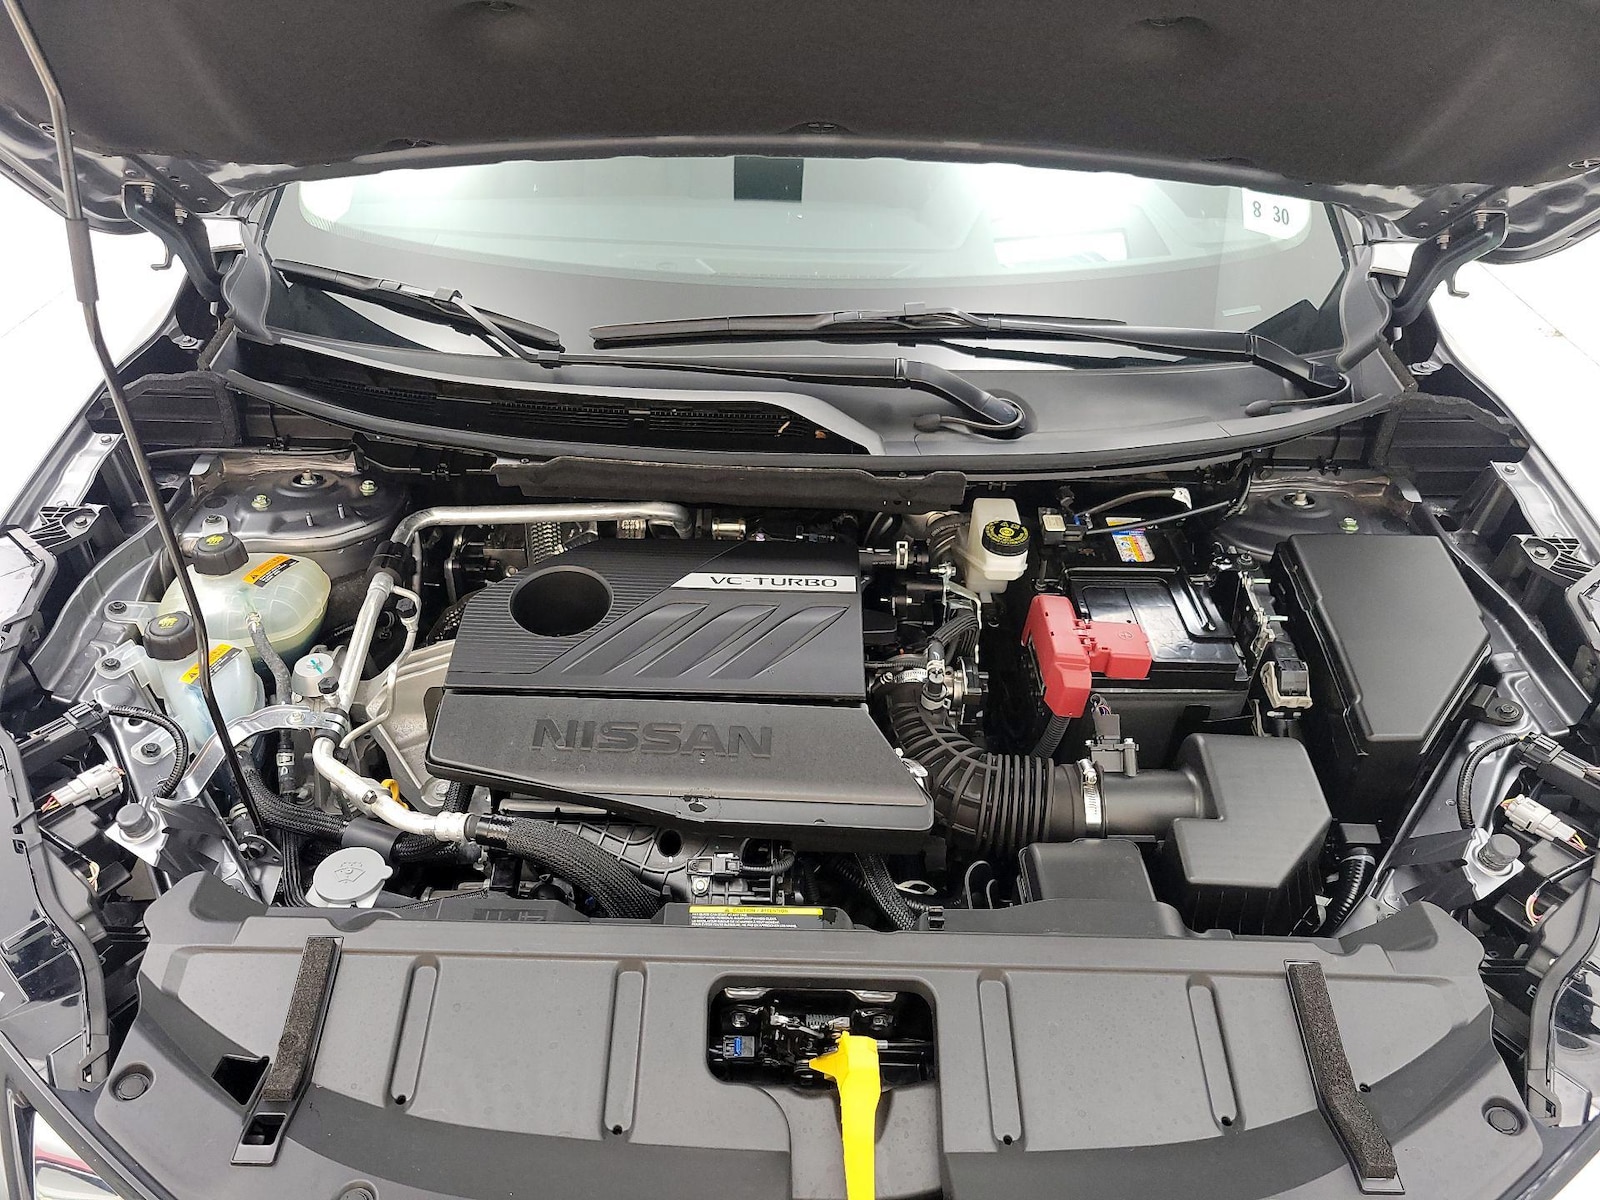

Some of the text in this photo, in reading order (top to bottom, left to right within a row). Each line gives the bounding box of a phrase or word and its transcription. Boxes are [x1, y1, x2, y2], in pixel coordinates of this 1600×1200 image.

[1252, 200, 1290, 225] 8 30
[709, 576, 838, 588] VC-TURBO
[532, 718, 773, 758] NISSAN
